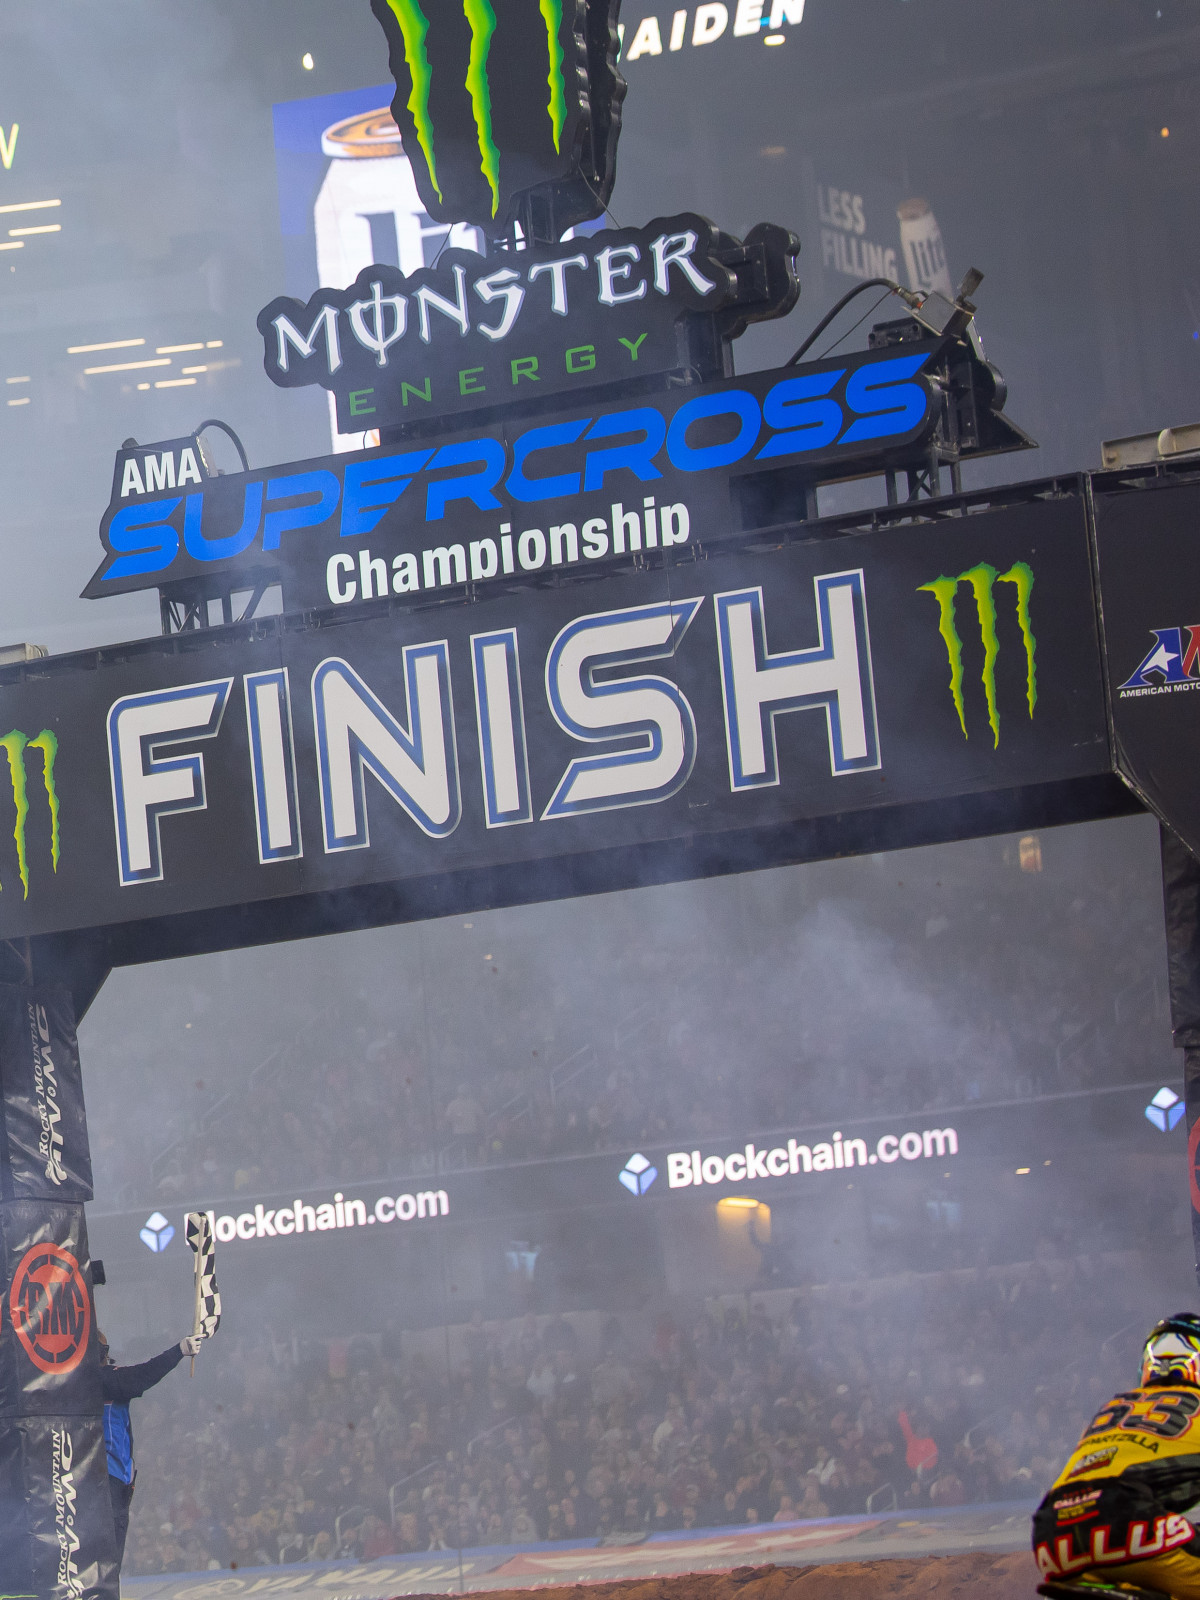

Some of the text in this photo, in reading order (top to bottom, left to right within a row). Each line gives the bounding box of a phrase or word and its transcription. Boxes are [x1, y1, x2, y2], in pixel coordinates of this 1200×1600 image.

[616, 0, 806, 63] AIDEN
[817, 184, 866, 236] LESS
[820, 230, 899, 283] FILLING
[273, 228, 716, 376] MONSTER
[349, 332, 649, 417] ENERGY
[100, 352, 931, 580] SUPERCROSS
[120, 446, 202, 497] AMA
[325, 496, 691, 604] Championship
[1120, 686, 1172, 698] AMERICAN
[106, 568, 883, 886] FINISH
[26, 1002, 51, 1156] ROCKY MOUNTAIN
[667, 1126, 958, 1189] Blockchain.com
[185, 1189, 450, 1246] lockchain.com
[26, 1280, 78, 1336] RM
[51, 1429, 69, 1586] ROCKY MOUNTAIN
[1036, 1514, 1194, 1577] ALLUS
